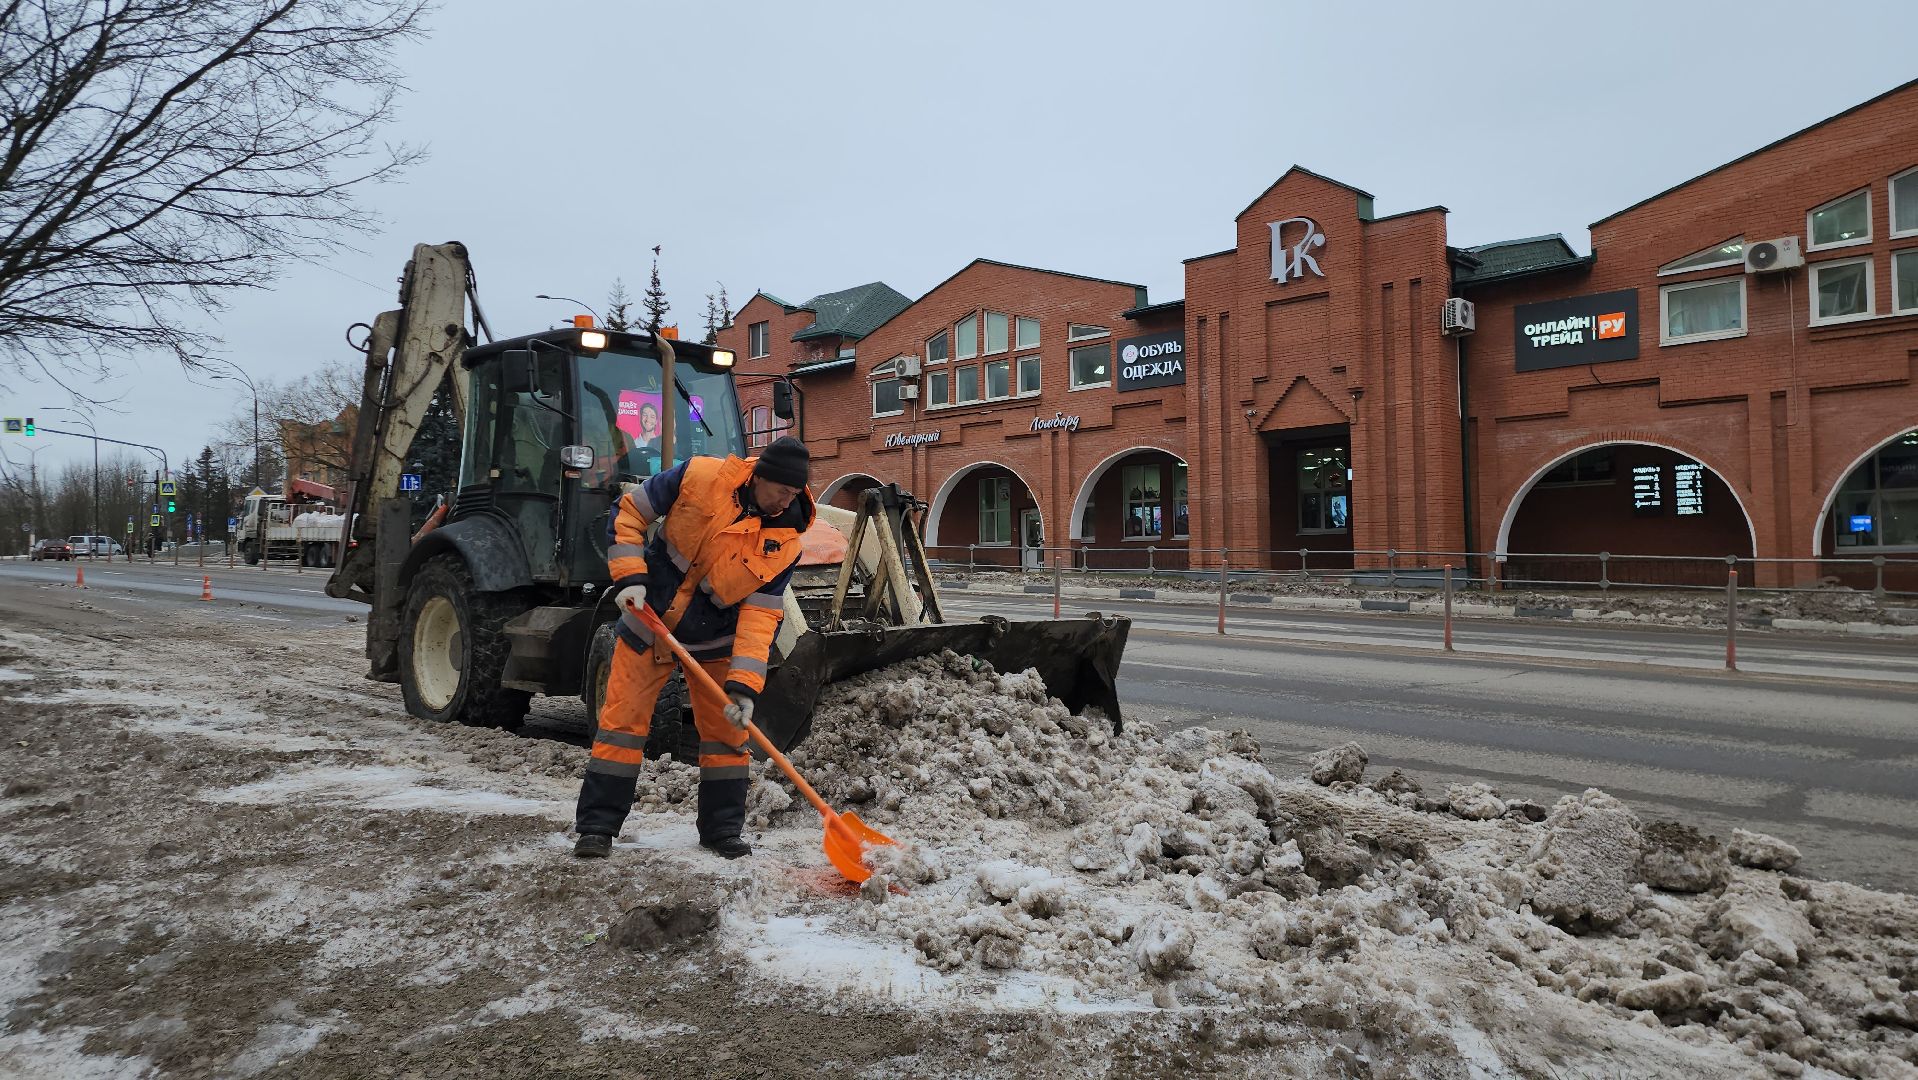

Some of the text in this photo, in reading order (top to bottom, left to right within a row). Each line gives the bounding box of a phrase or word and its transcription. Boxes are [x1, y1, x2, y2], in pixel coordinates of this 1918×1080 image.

[1524, 316, 1591, 336] ОНЛАЙН
[1599, 317, 1624, 335] РУ
[1531, 330, 1584, 348] ТРЕЙД
[1139, 341, 1182, 358] ОБУВЬ
[1122, 359, 1183, 381] ОДЕЖДА
[1029, 412, 1080, 432] Ломбард
[885, 430, 942, 447] Ювелирный
